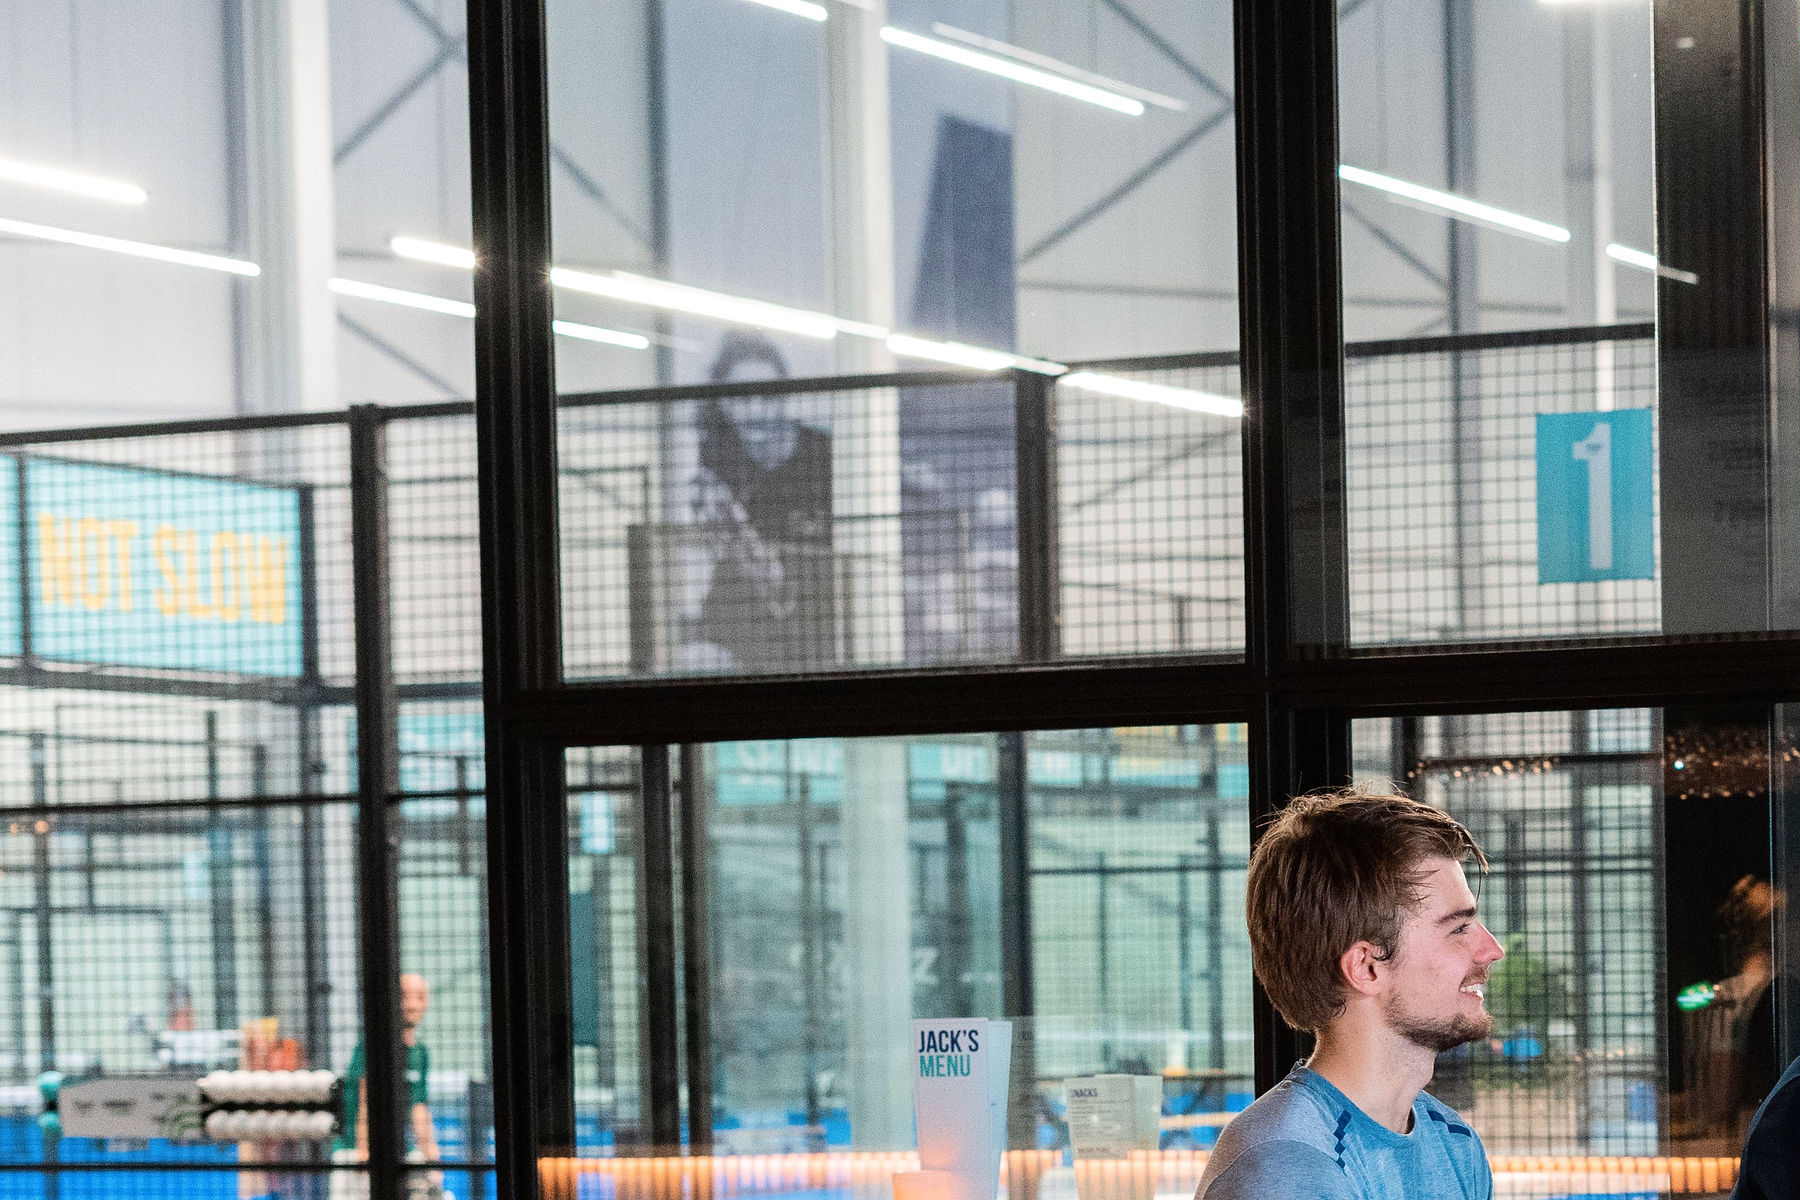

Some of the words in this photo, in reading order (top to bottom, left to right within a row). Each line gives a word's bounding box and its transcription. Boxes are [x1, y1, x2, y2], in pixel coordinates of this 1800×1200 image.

[1571, 421, 1614, 571] 1
[37, 511, 139, 613] NOT
[152, 523, 287, 625] SLOW
[918, 1029, 979, 1053] JACK'S
[919, 1054, 971, 1078] MENU
